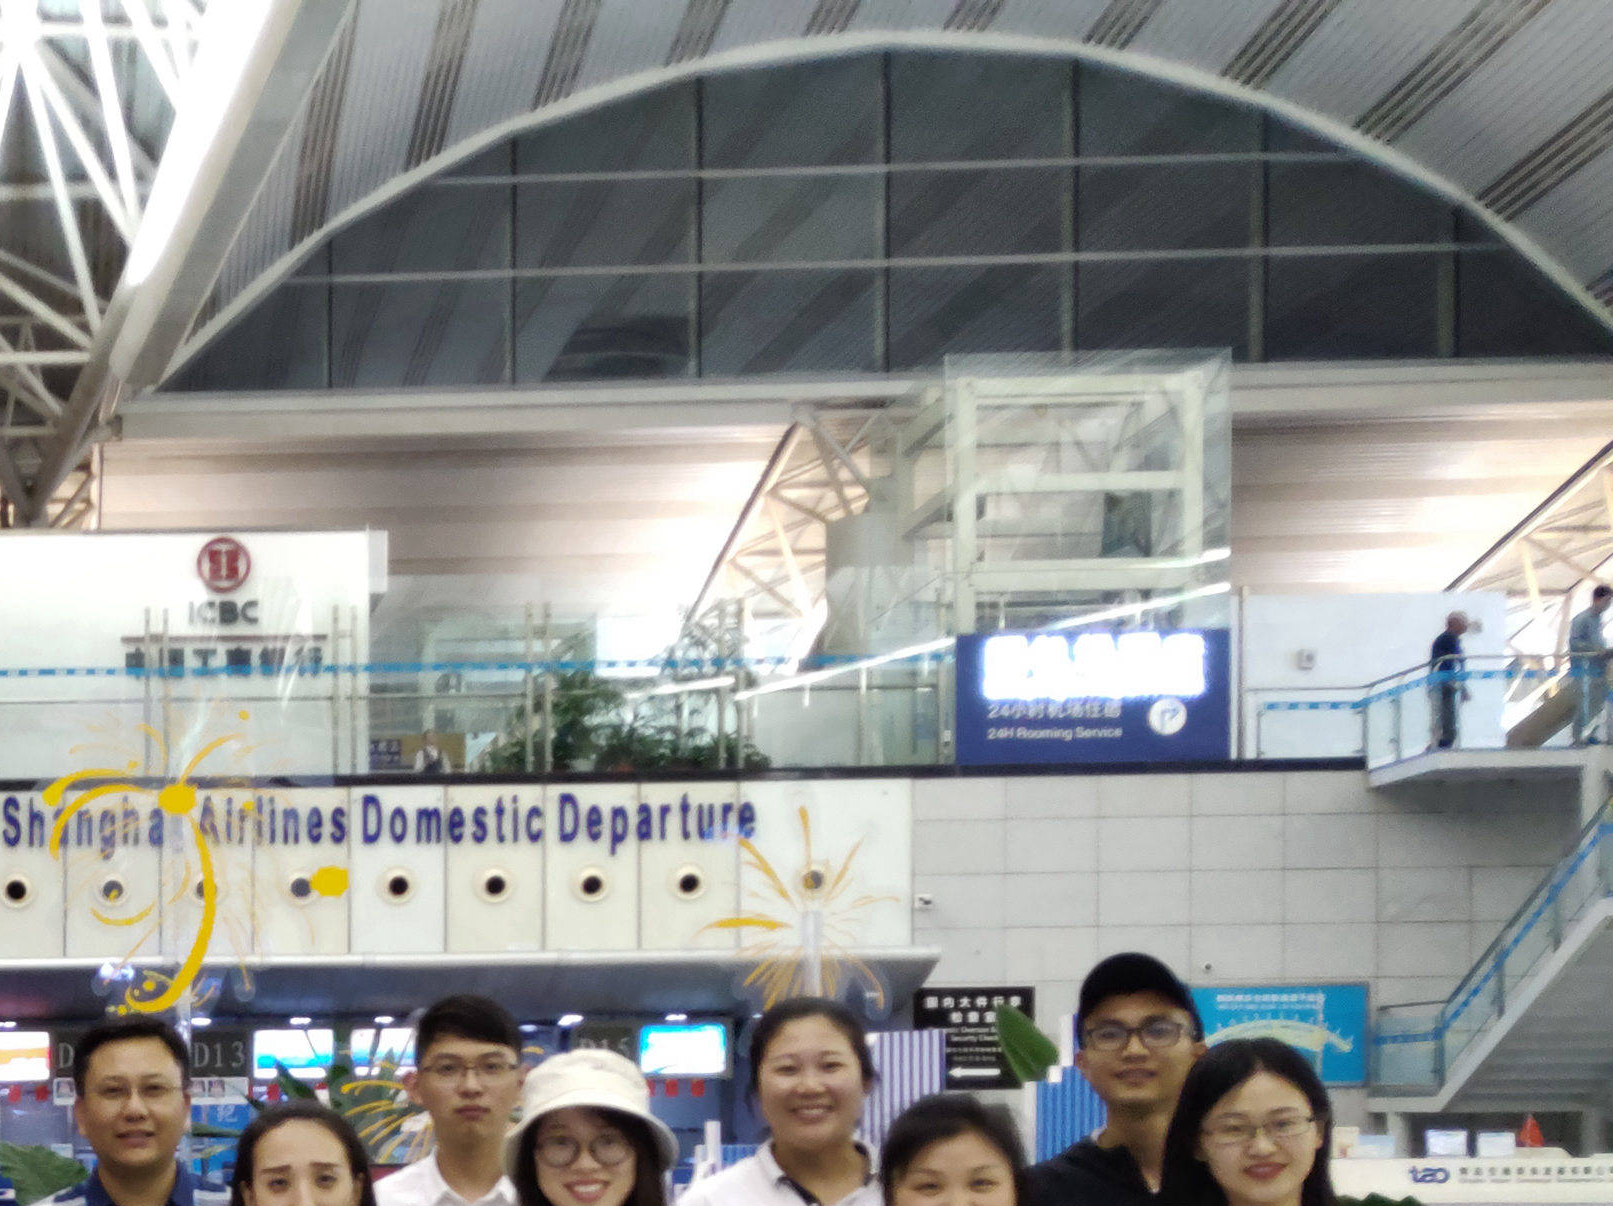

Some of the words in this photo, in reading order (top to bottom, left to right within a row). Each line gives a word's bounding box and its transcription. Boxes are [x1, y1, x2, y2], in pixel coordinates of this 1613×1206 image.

[189, 599, 259, 625] ICBC
[361, 793, 544, 845] Domestic
[559, 792, 756, 856] Departure
[193, 1041, 247, 1069] D13
